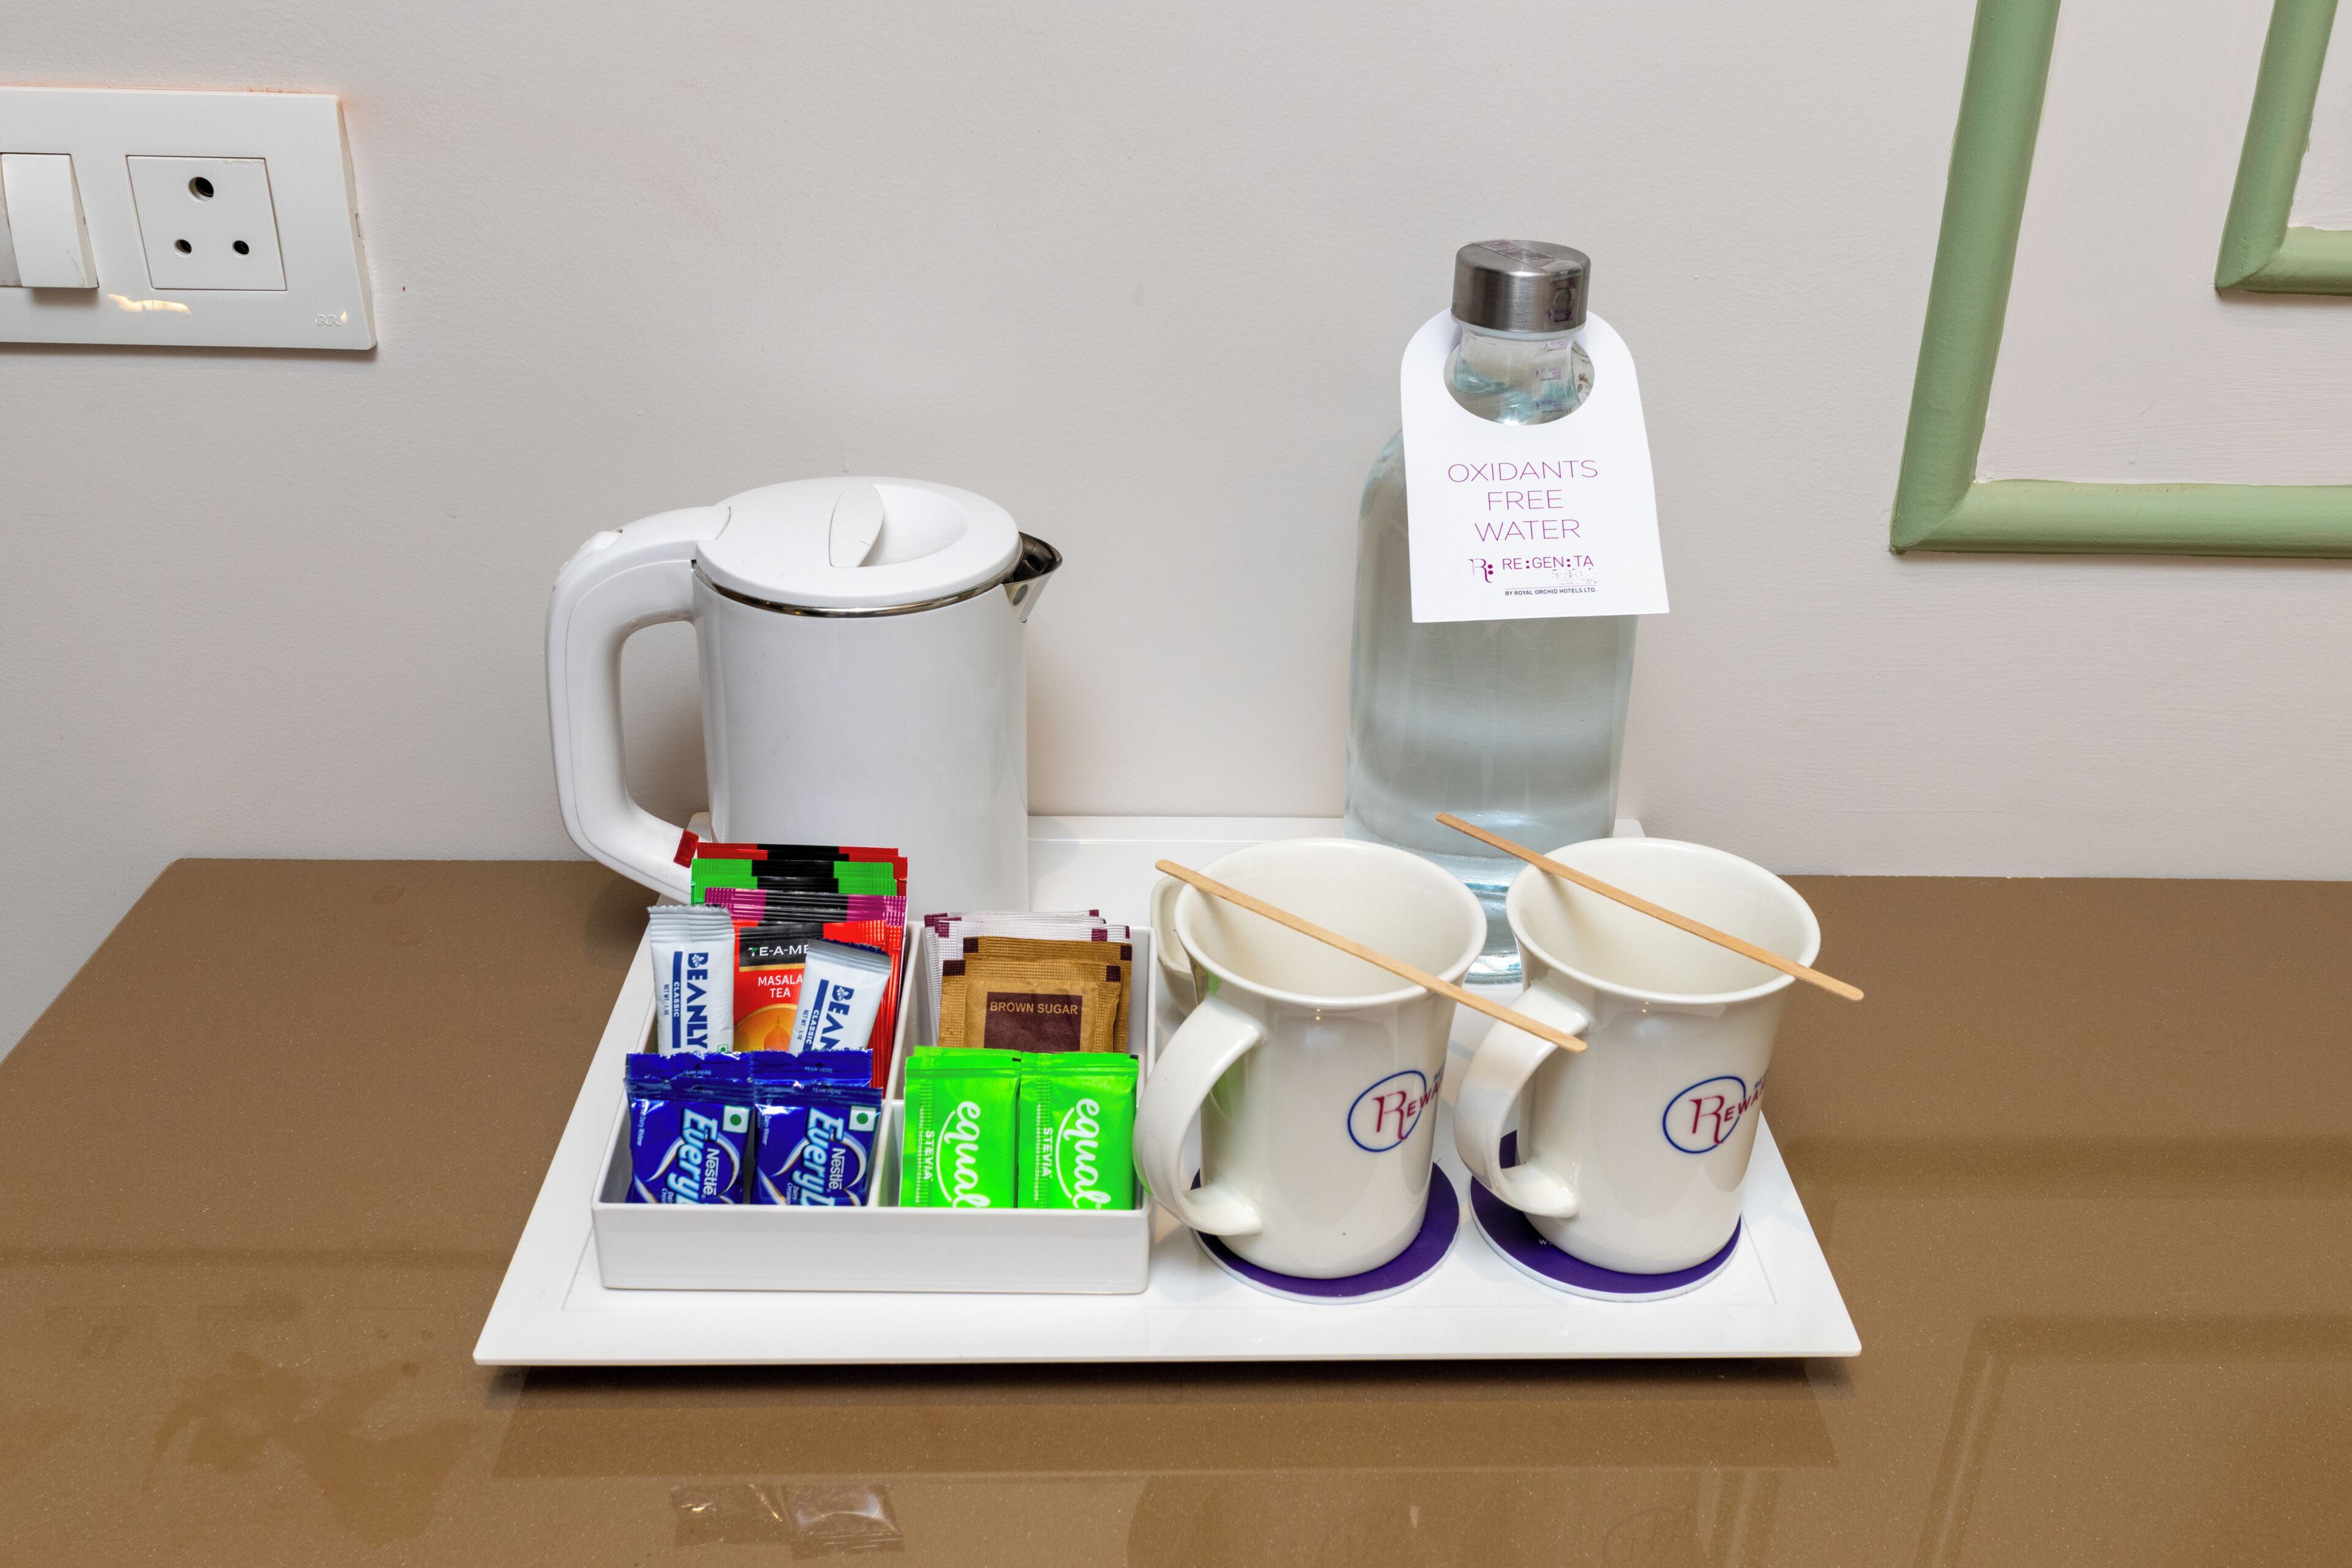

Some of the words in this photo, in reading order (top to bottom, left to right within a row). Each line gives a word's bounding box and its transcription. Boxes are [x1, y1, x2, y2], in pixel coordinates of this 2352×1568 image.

[1448, 460, 1597, 482] OXIDANTS
[1488, 489, 1564, 510] FREE
[1475, 519, 1580, 541] WATER
[1502, 555, 1594, 570] RE:GEN:TA
[758, 974, 803, 986] MASALA
[687, 952, 709, 1049] BEANLY
[770, 987, 791, 998] TEA
[990, 1001, 1034, 1013] BROWN
[1037, 1003, 1078, 1015] SUGAR
[806, 1009, 820, 1045] CLASSIC
[924, 1130, 935, 1181] STEVIA
[943, 1101, 991, 1208] equal
[1042, 1127, 1053, 1177] STEVIA
[1063, 1098, 1111, 1208] equal
